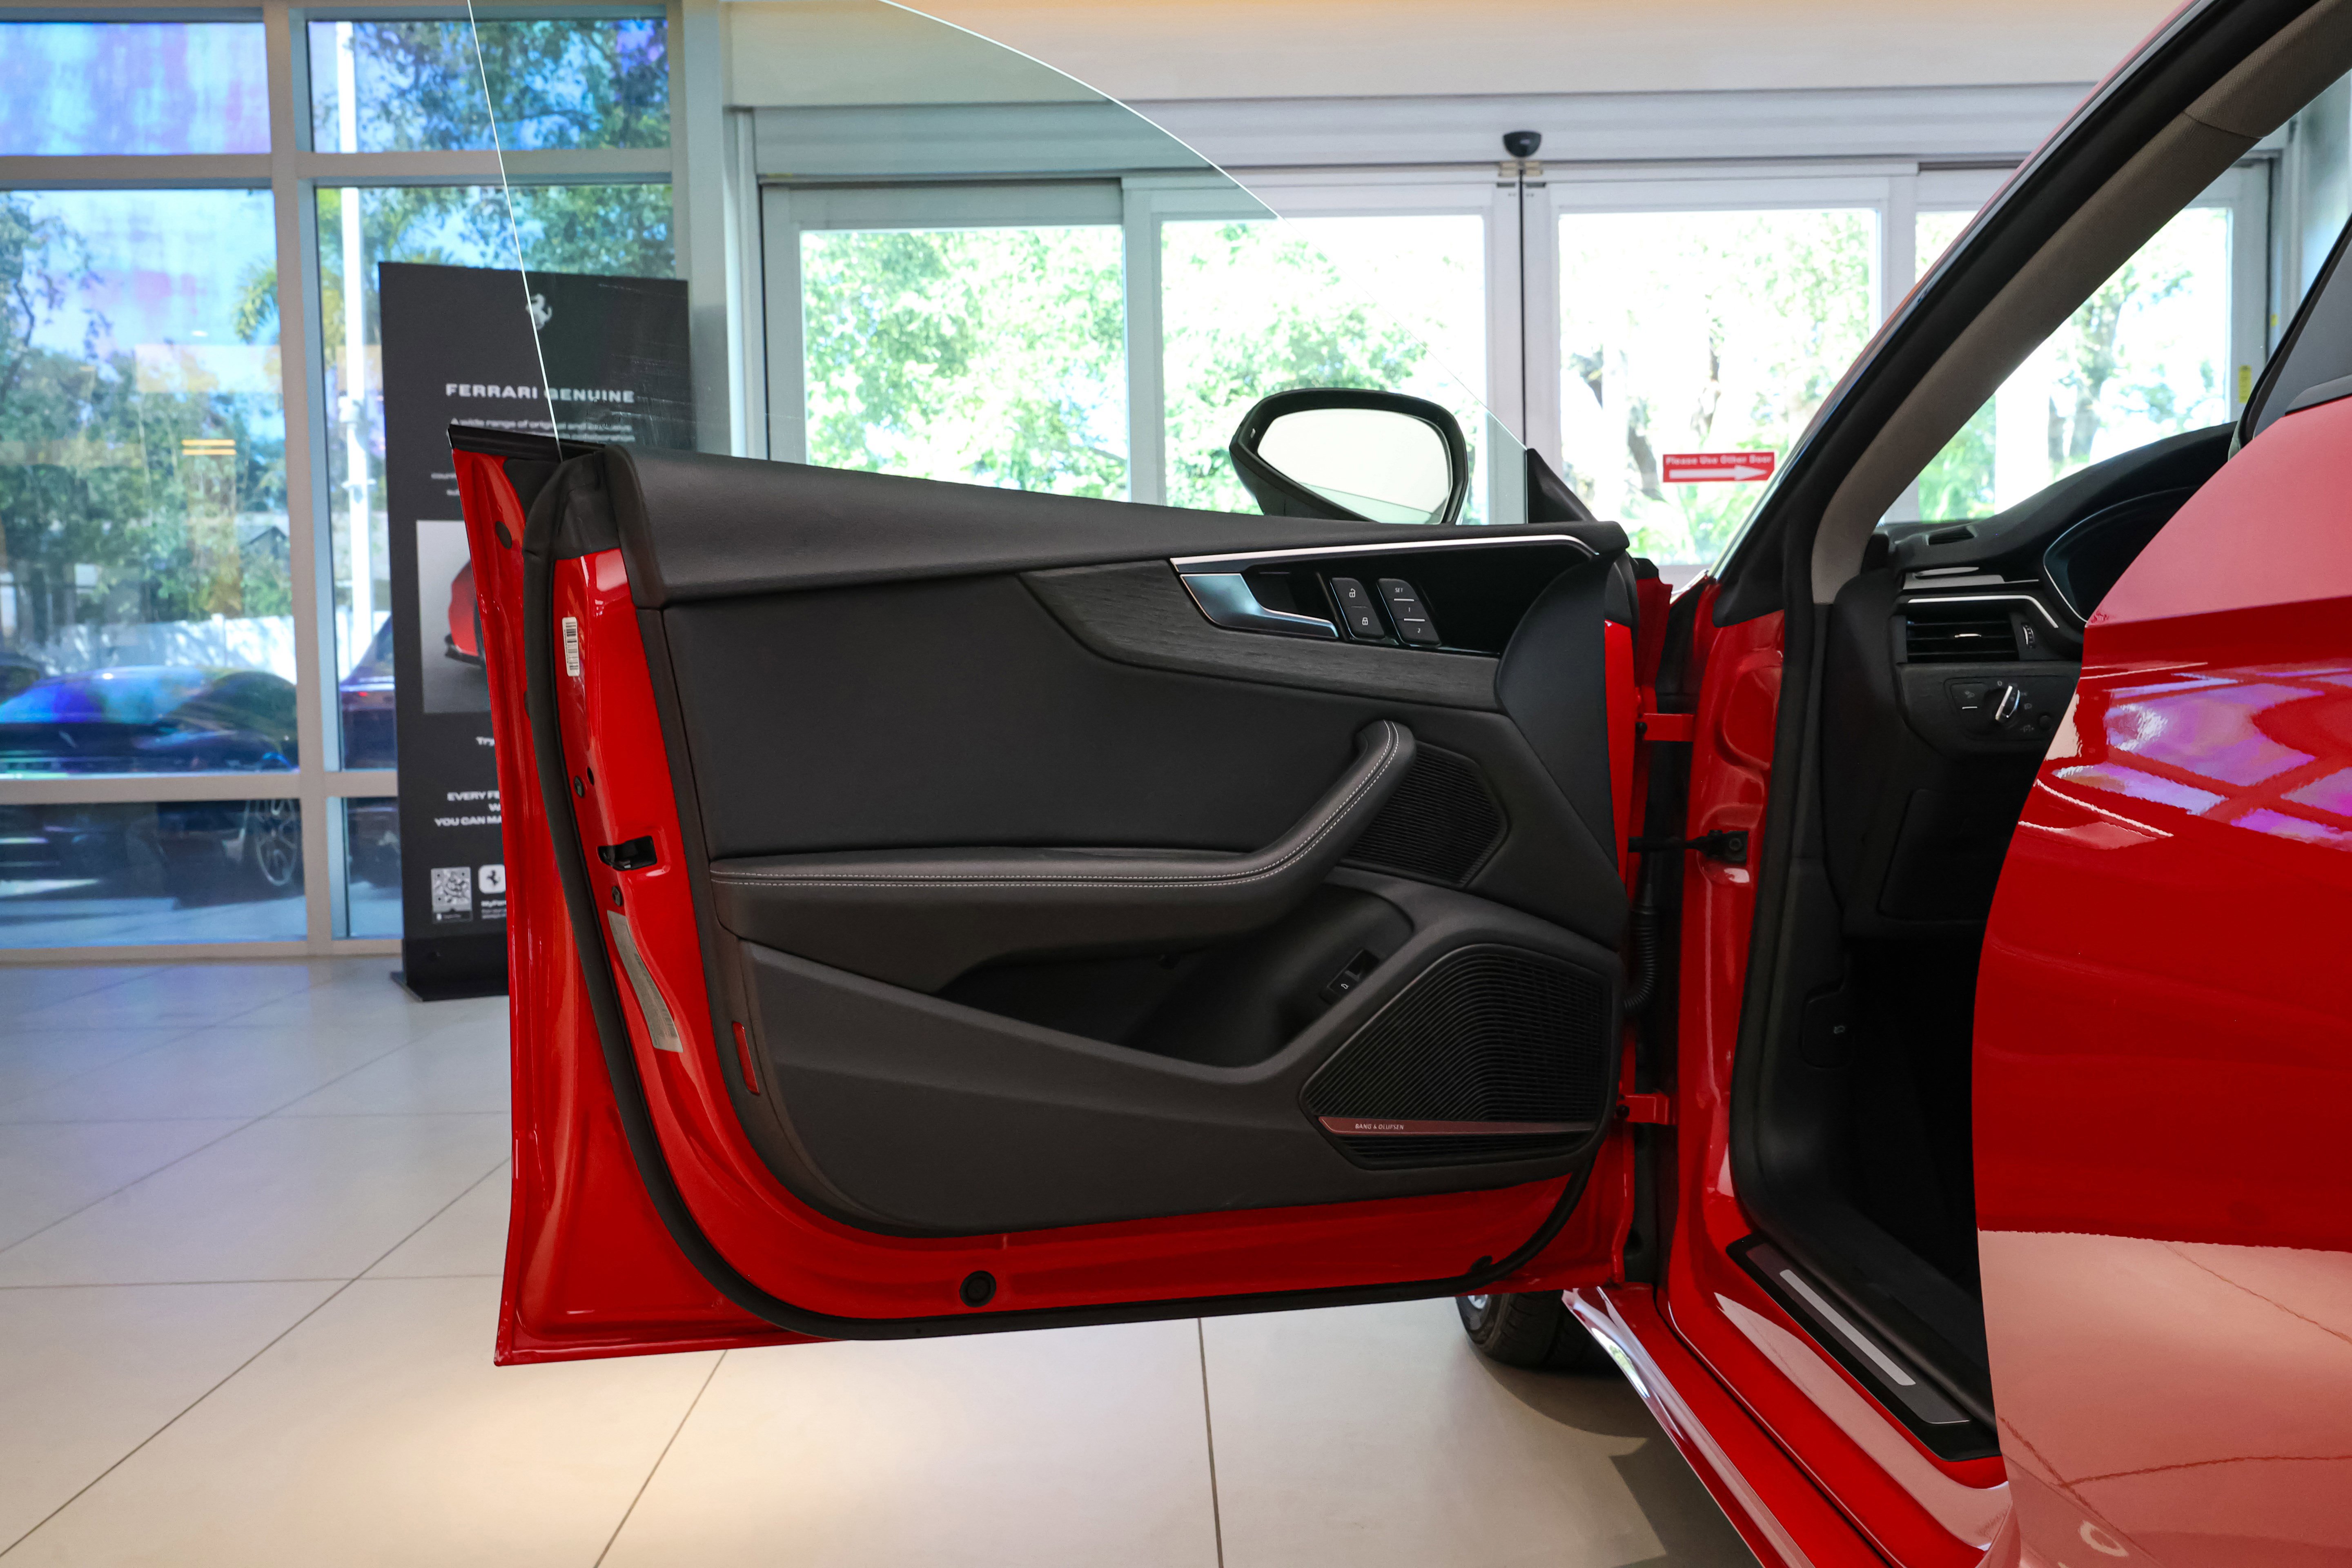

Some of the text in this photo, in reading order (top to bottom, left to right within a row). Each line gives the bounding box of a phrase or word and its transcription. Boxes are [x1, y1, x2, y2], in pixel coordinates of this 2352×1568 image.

[446, 383, 635, 403] FERRARI GENUINE
[1666, 454, 1772, 465] Please Use Other Door
[447, 791, 486, 801] EVERY
[434, 817, 460, 827] YOU
[460, 816, 486, 826] CAN
